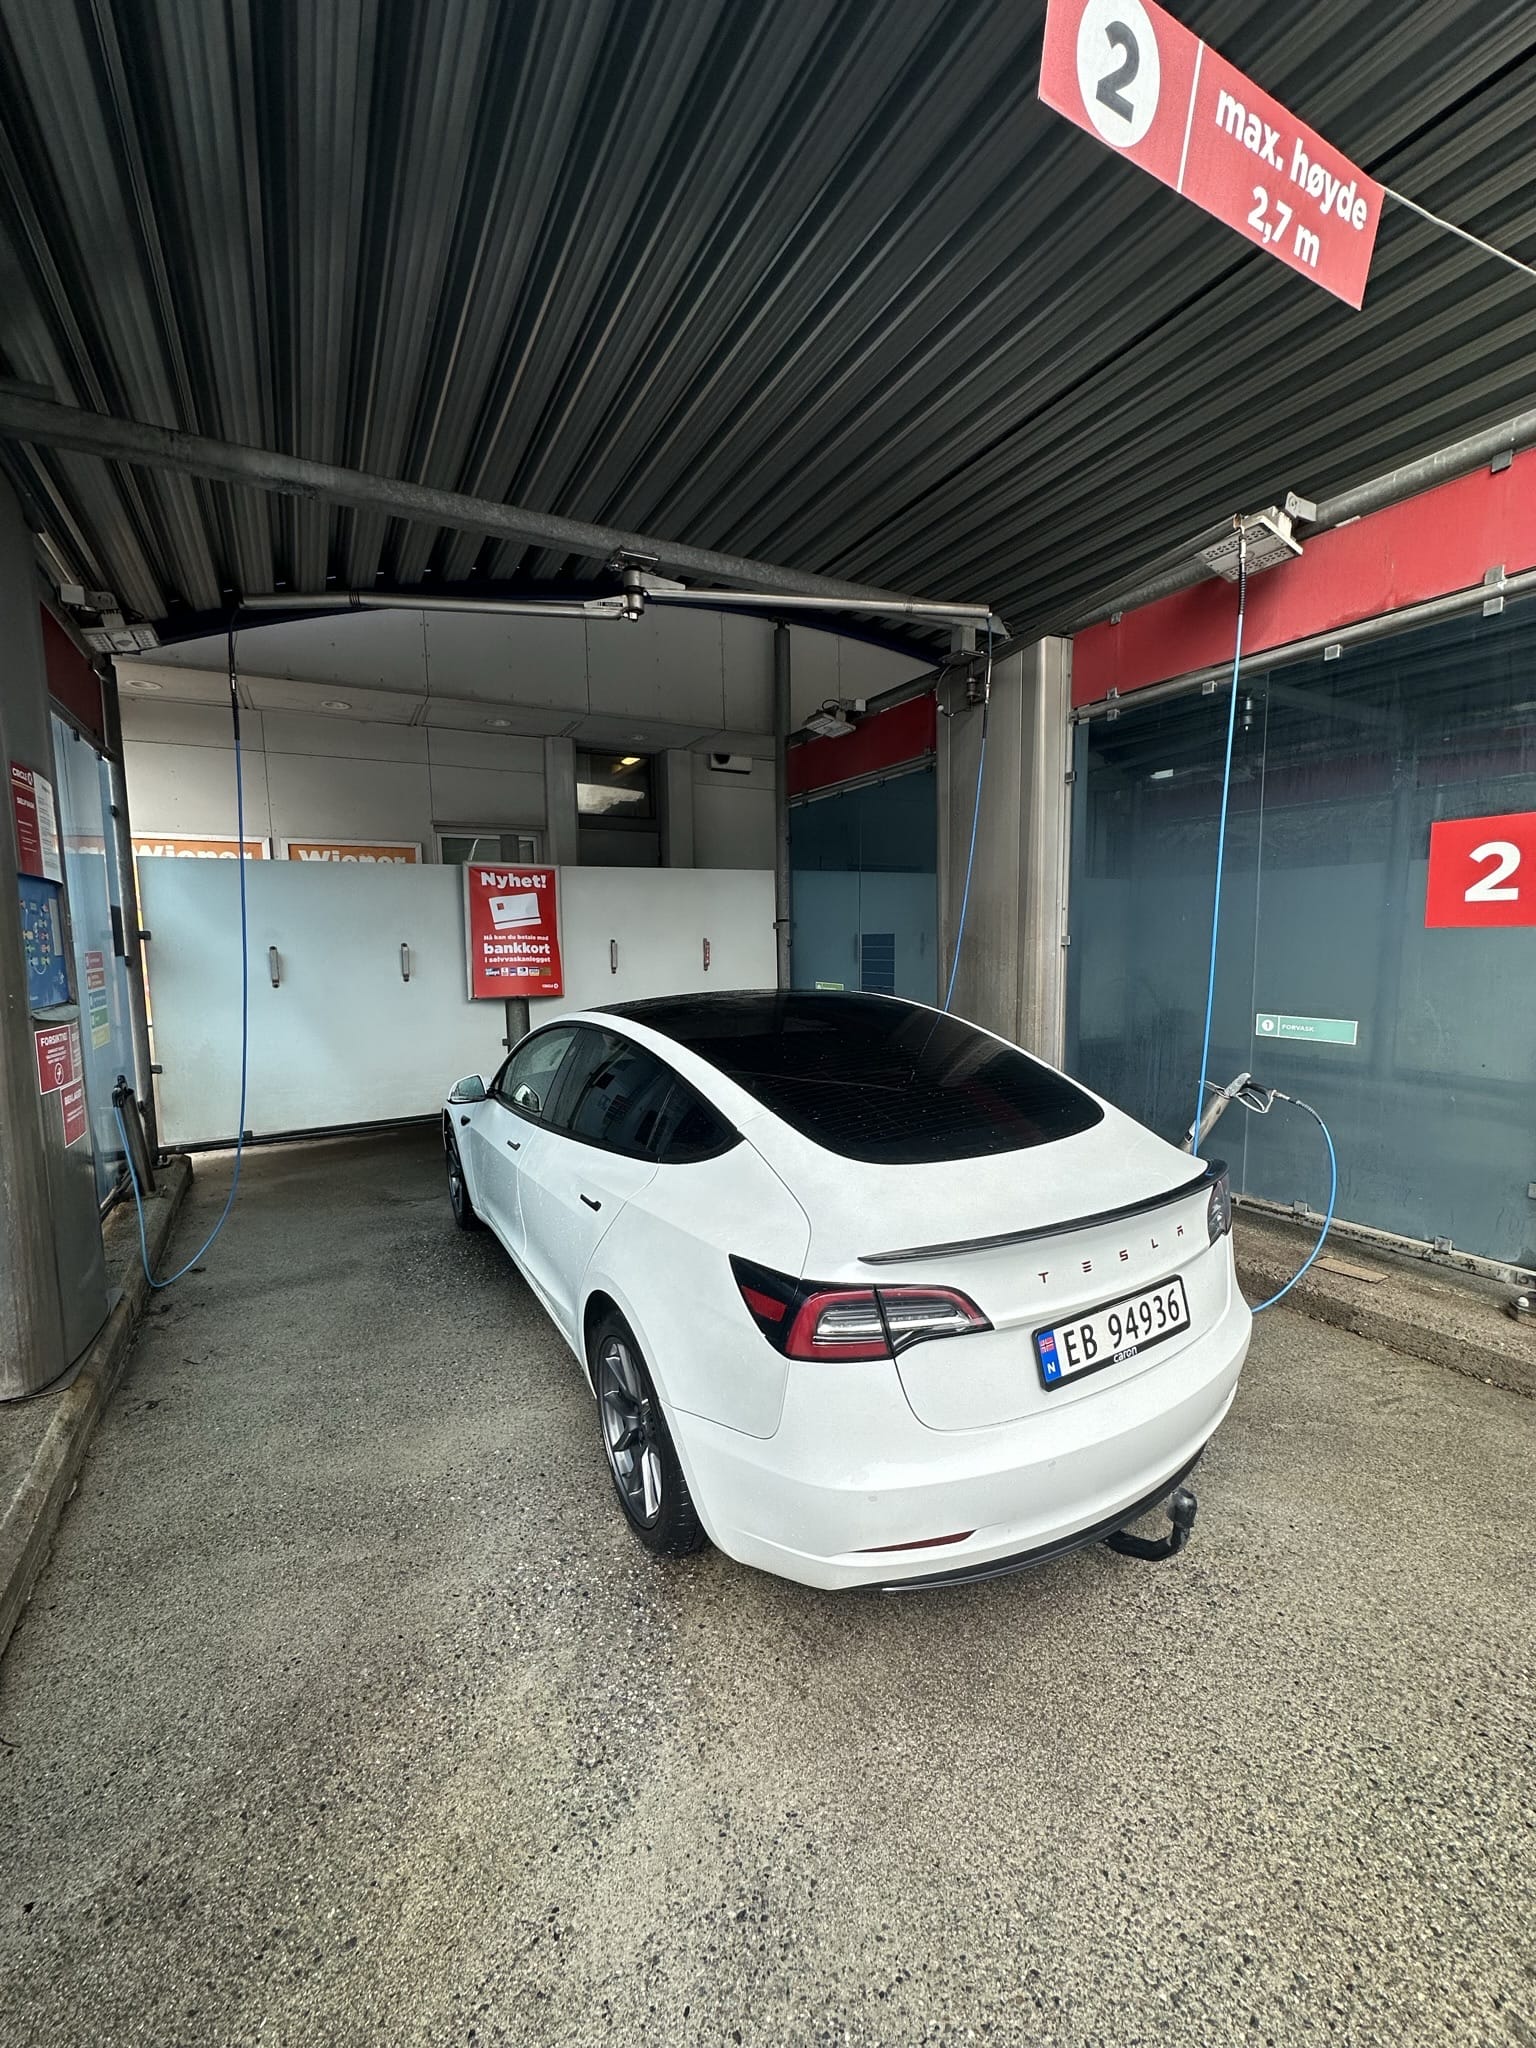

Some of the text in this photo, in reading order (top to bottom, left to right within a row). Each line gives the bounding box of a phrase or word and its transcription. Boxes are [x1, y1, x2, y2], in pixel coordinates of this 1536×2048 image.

[1095, 20, 1141, 123] 2
[1214, 89, 1369, 231] max. høyde
[1246, 187, 1321, 267] 2,7 m
[480, 871, 547, 889] Nyhet!
[1464, 841, 1521, 902] 2
[483, 942, 551, 955] bankkort
[1281, 1023, 1315, 1033] FORVASK
[1038, 1225, 1185, 1284] TESLA
[1063, 1289, 1181, 1367] EB 94936
[1112, 1346, 1138, 1363] caron
[1046, 1361, 1056, 1374] N
